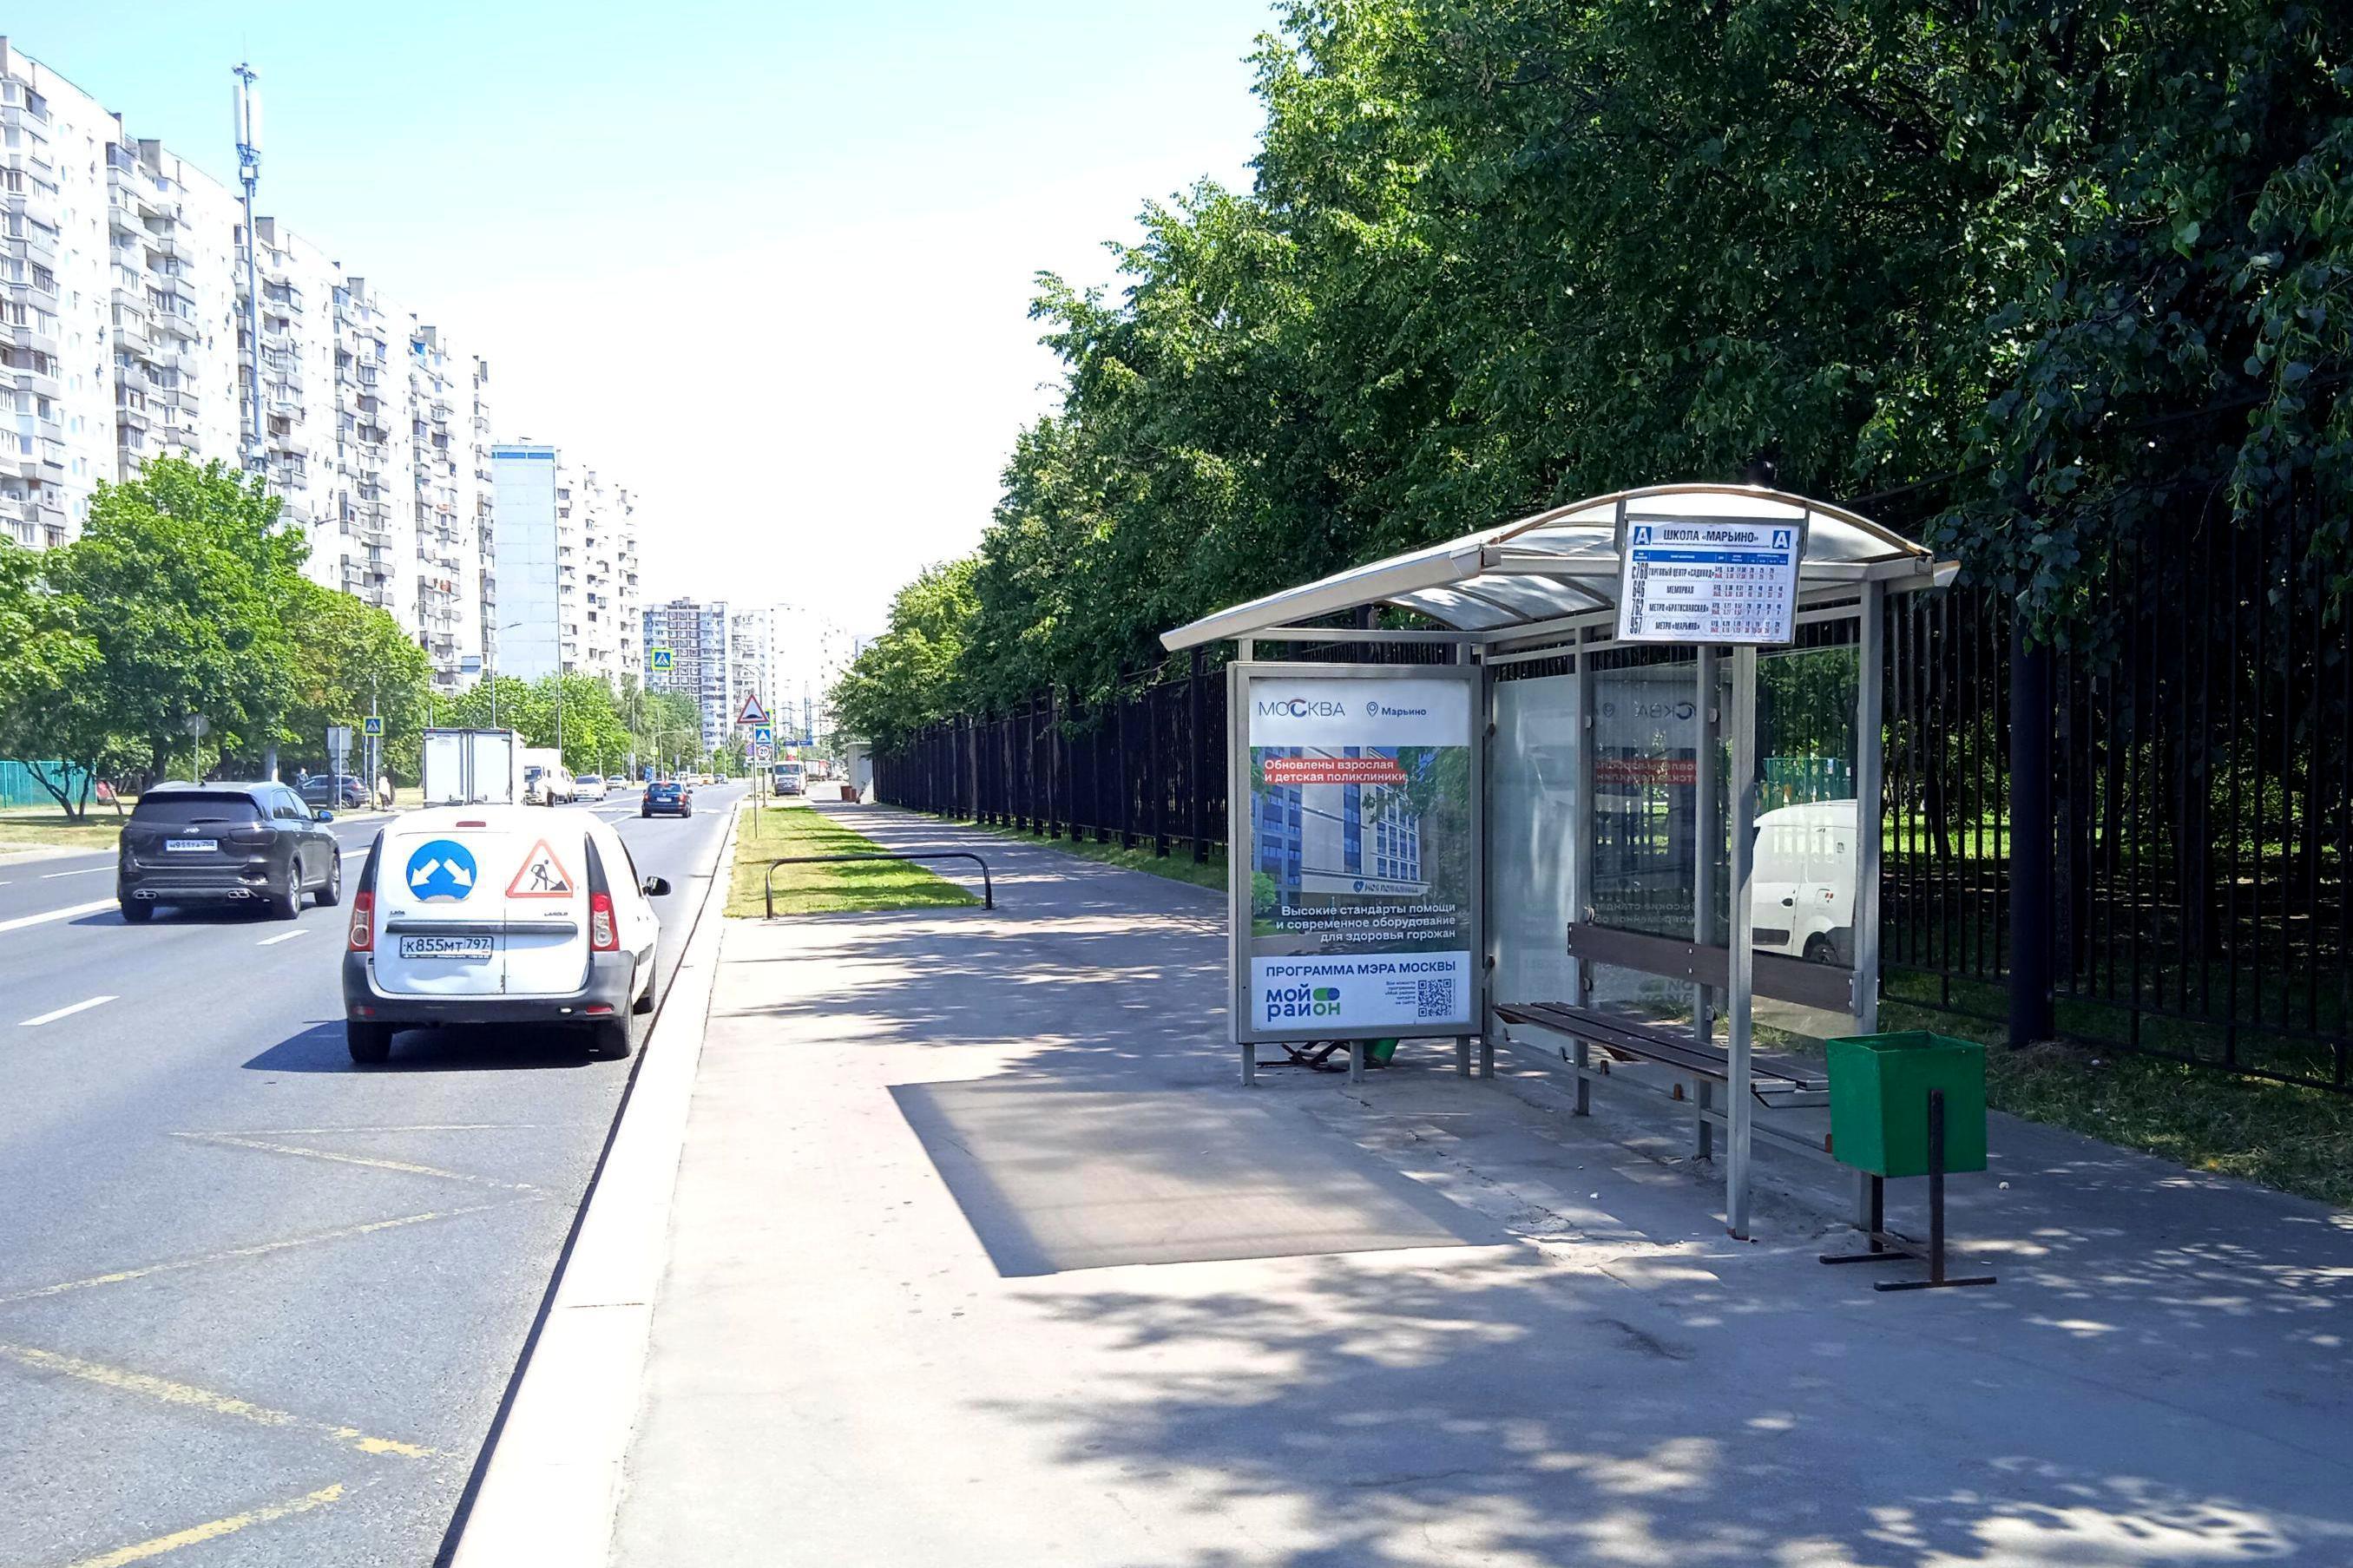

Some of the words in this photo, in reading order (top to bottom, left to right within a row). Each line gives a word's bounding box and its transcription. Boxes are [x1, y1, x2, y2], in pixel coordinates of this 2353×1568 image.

[1664, 529, 1699, 541] ШКОЛА
[1702, 531, 1758, 543] «МАРЬИНО»
[1633, 581, 1645, 597] 646
[1631, 599, 1644, 615] 762
[1630, 617, 1642, 634] 957
[1259, 699, 1345, 718] МОСКВА
[1382, 707, 1427, 718] Марьино
[1265, 759, 1335, 771] Обновлены
[1338, 760, 1394, 772] взрослая
[1265, 773, 1272, 782] и
[1275, 772, 1324, 783] детская
[1327, 772, 1406, 782] поликлиники
[1281, 905, 1338, 916] Высокие
[1340, 905, 1406, 916] стандарты
[1410, 903, 1456, 915] помощи
[1276, 921, 1284, 929] и
[1287, 919, 1370, 931] современное
[1373, 916, 1456, 929] оборудование
[1320, 932, 1344, 943] для
[1345, 931, 1403, 942] здоровья
[1407, 929, 1456, 941] горожан
[406, 938, 463, 952] К855МТ
[466, 938, 489, 949] 797
[1266, 964, 1354, 977] ПРОГРАММА
[1357, 962, 1397, 975] МЭРА
[1399, 961, 1456, 973] МОСКВЫ
